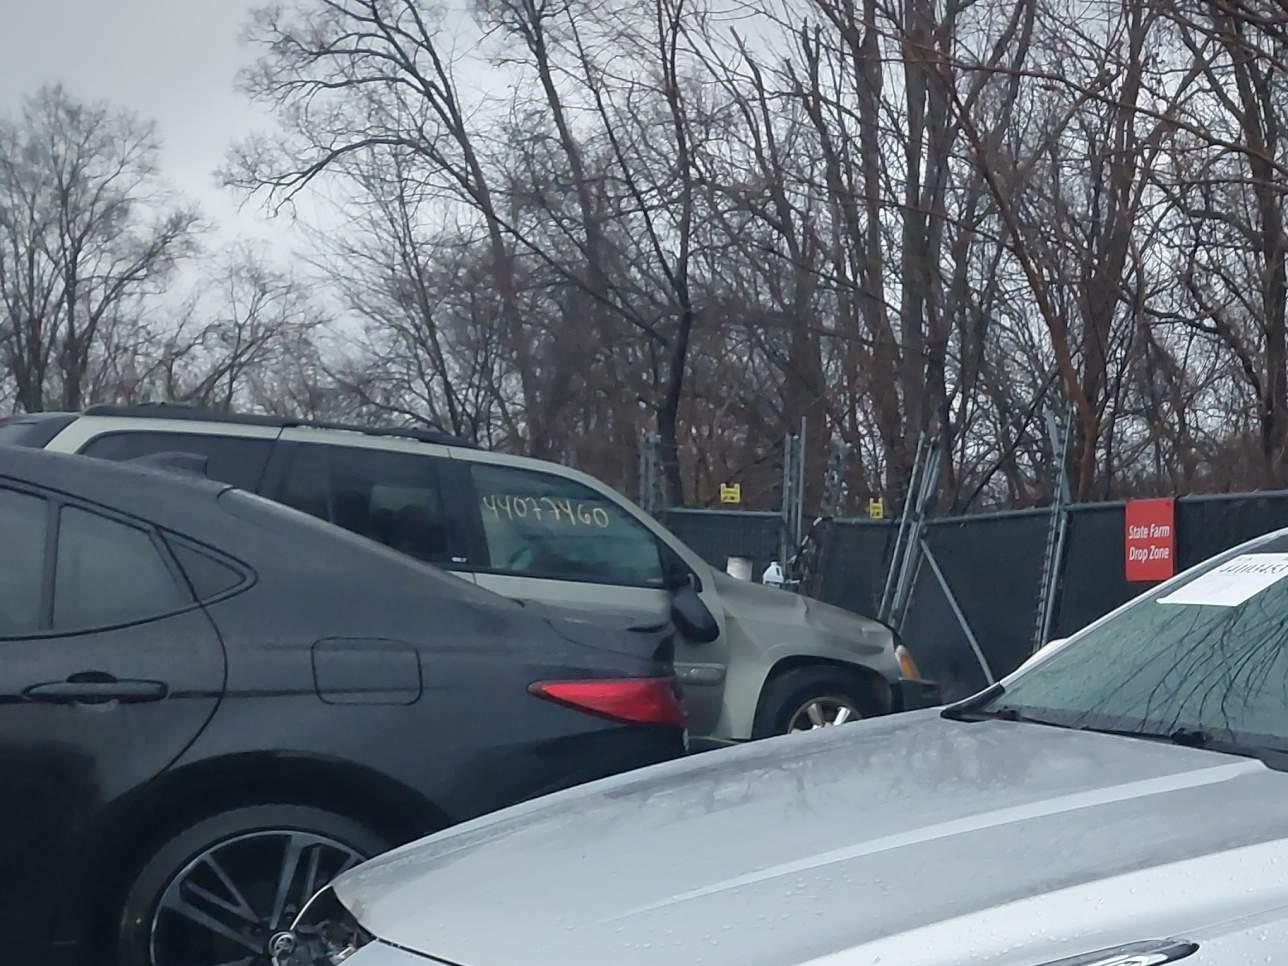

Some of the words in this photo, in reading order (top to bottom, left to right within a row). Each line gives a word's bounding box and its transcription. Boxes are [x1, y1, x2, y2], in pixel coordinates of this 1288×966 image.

[482, 495, 609, 528] 44077460
[1128, 525, 1148, 539] State
[1150, 523, 1170, 538] Farm
[1129, 546, 1148, 563] Drop
[1149, 545, 1169, 560] Zone
